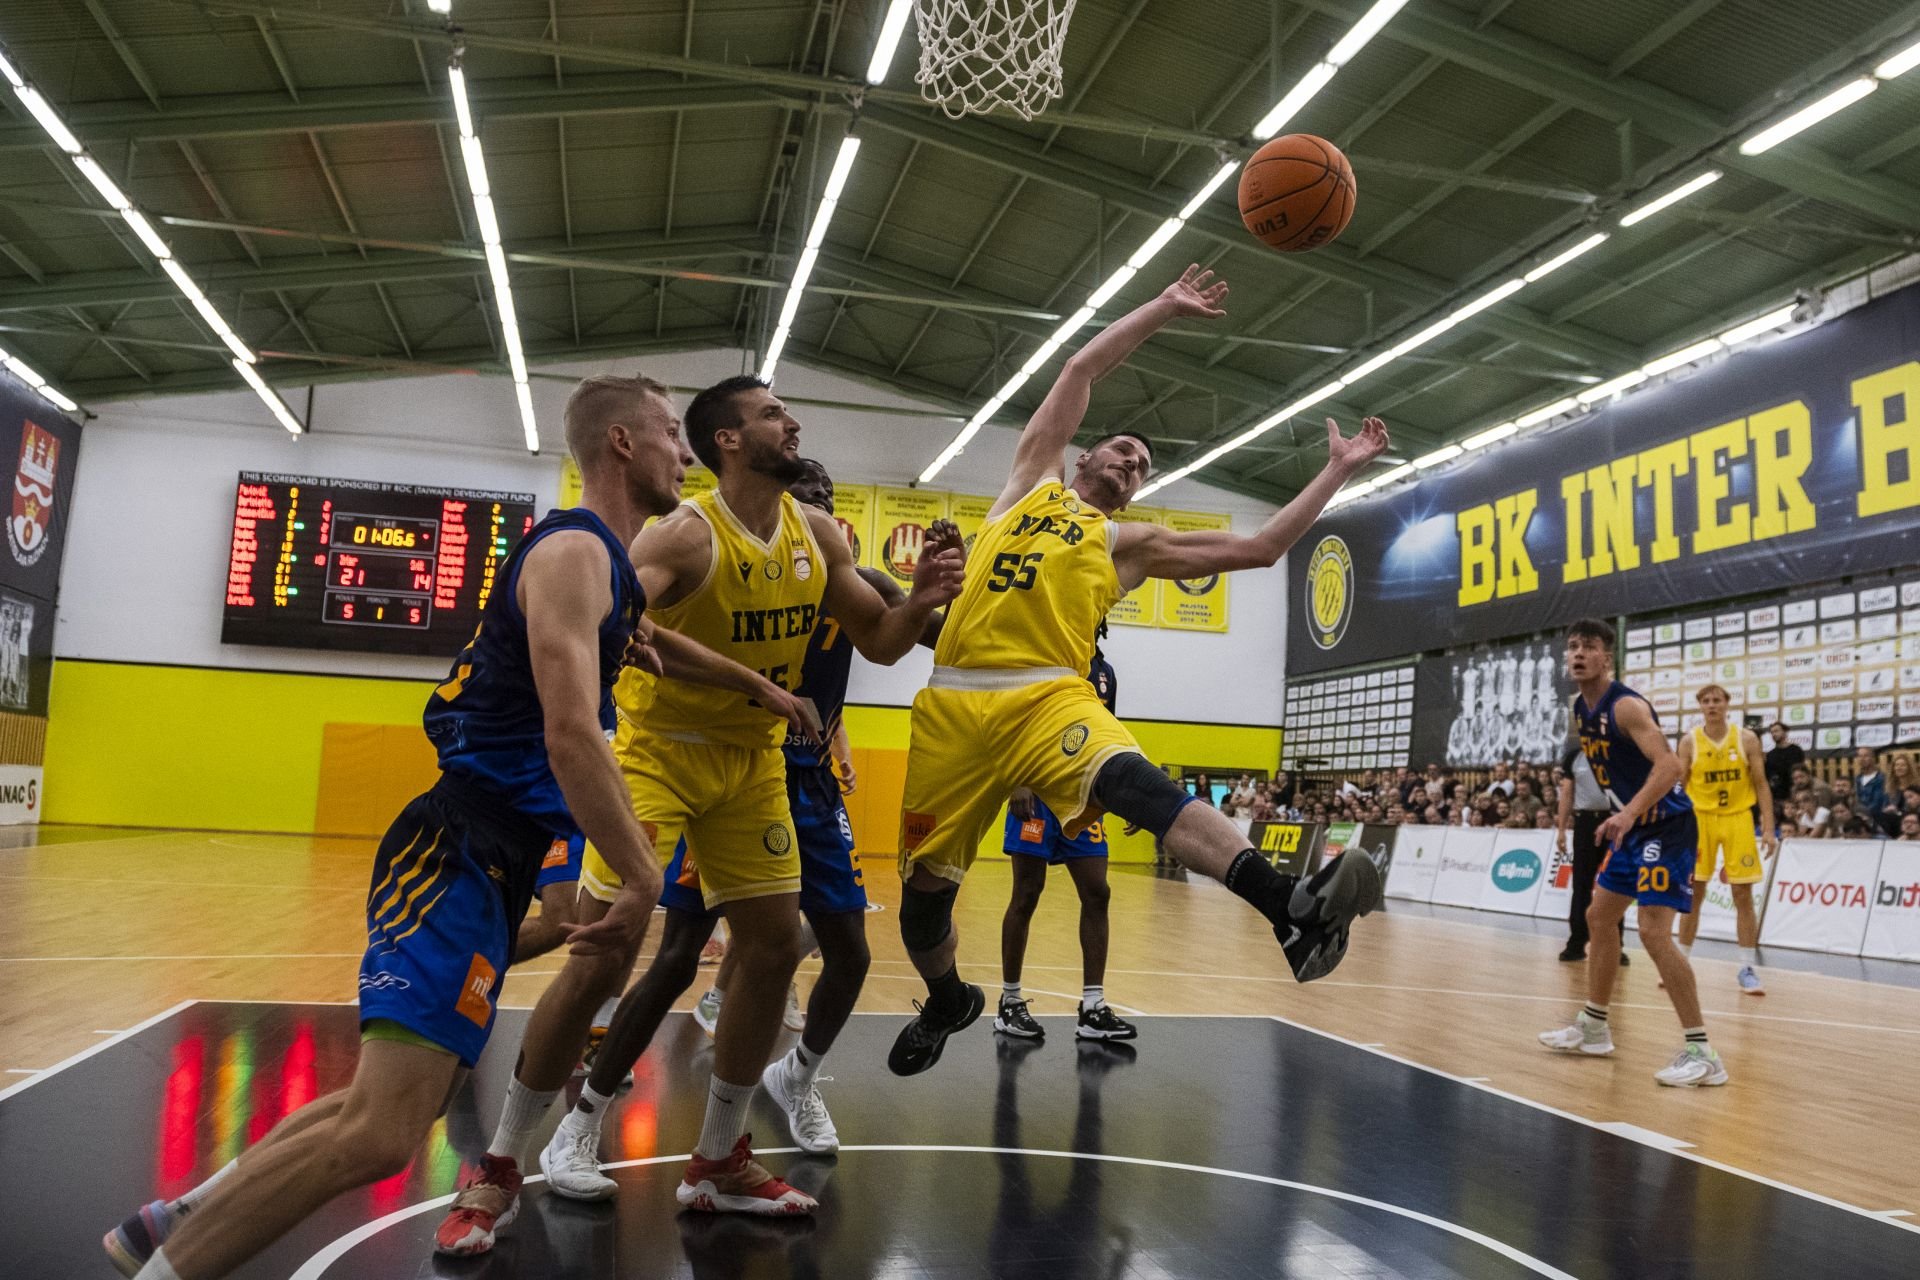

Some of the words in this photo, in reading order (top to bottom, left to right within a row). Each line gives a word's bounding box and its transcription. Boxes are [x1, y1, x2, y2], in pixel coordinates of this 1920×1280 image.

[242, 472, 260, 481] THIS
[262, 473, 318, 486] SCOREBOARD
[320, 478, 328, 487] IS
[330, 478, 380, 491] SPONSORED
[382, 484, 393, 492] BY
[454, 488, 509, 501] DEVELOPMENT
[510, 493, 533, 502] FUND
[1457, 489, 1539, 608] BK
[1561, 399, 1817, 584] INTER
[375, 519, 397, 528] TIME
[340, 567, 365, 586] 21
[987, 552, 1044, 592] 55
[414, 574, 432, 590] 14
[343, 604, 354, 619] 5
[377, 607, 384, 620] 1
[410, 608, 420, 623] 5
[731, 603, 817, 643] INTER
[1704, 769, 1742, 784] INTER
[0, 785, 25, 804] NAC
[1718, 790, 1728, 807] 2
[1260, 825, 1302, 853] INTER
[1637, 866, 1670, 892] 20
[1777, 881, 1867, 908] TOYOTA
